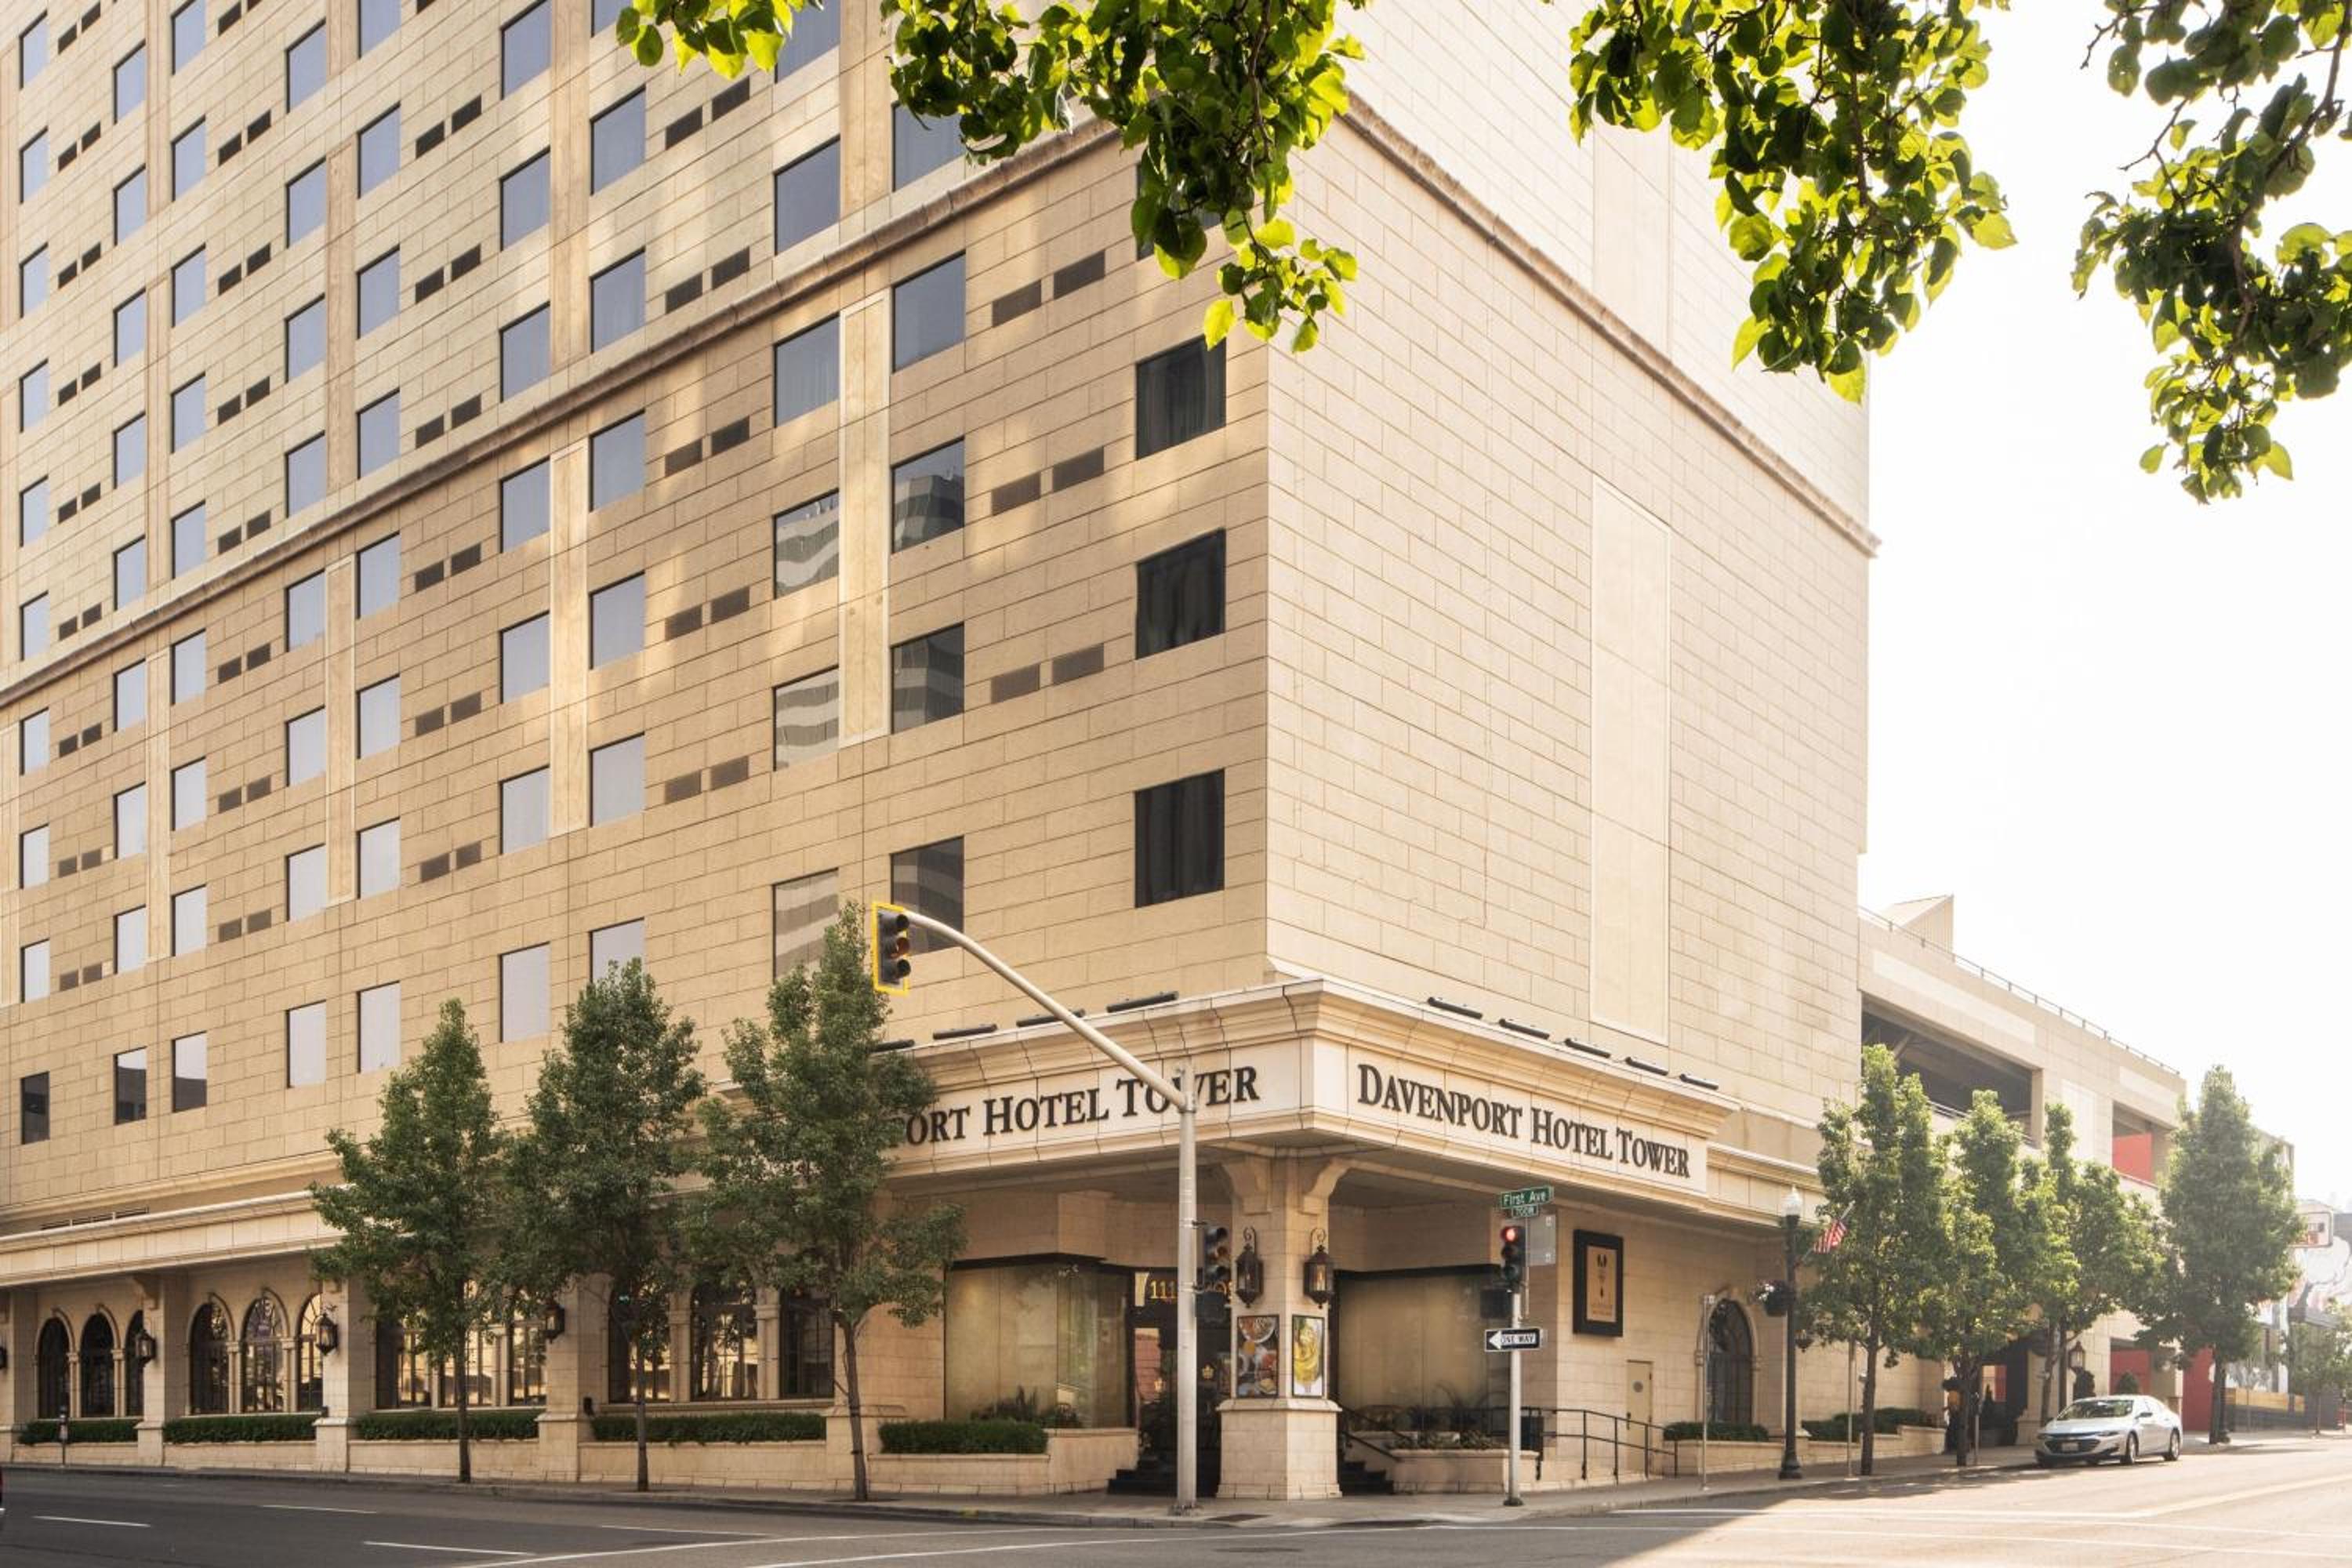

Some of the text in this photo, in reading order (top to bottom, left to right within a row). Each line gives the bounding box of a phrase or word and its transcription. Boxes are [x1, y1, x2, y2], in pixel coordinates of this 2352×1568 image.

[983, 1089, 1109, 1136] HOTEL
[1357, 1063, 1690, 1178] DAVENPORT HOTEL TOWER
[1503, 1190, 1546, 1207] First Ave
[1150, 1279, 1178, 1299] 111
[1518, 1334, 1536, 1343] WAY
